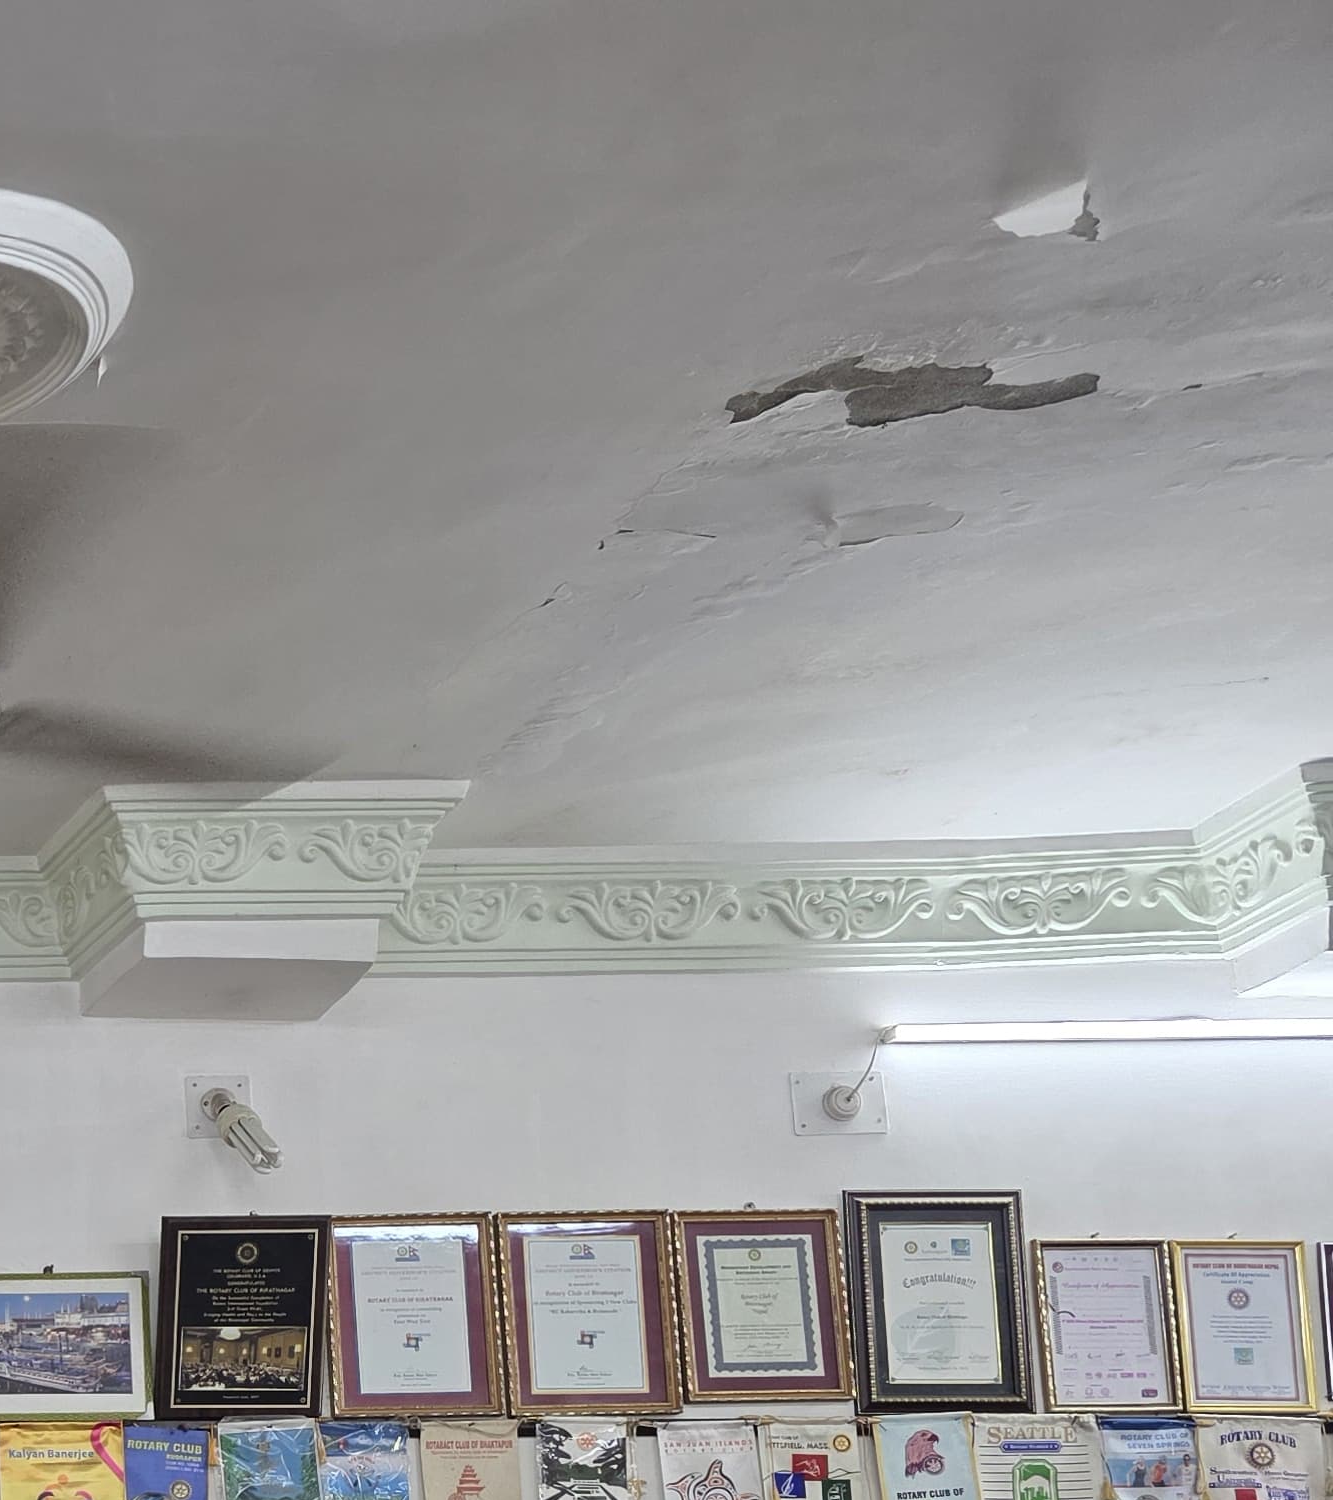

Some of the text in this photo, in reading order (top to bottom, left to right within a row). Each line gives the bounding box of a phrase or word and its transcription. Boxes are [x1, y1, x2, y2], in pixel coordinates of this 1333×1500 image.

[987, 1426, 1078, 1444] SEATTLE
[1220, 1430, 1297, 1448] ROTARY CLUB
[127, 1440, 202, 1454] ROTARY CLUB
[9, 1450, 94, 1461] Kalyan Banerjee
[897, 1488, 964, 1500] ROTARY CLUB OF
